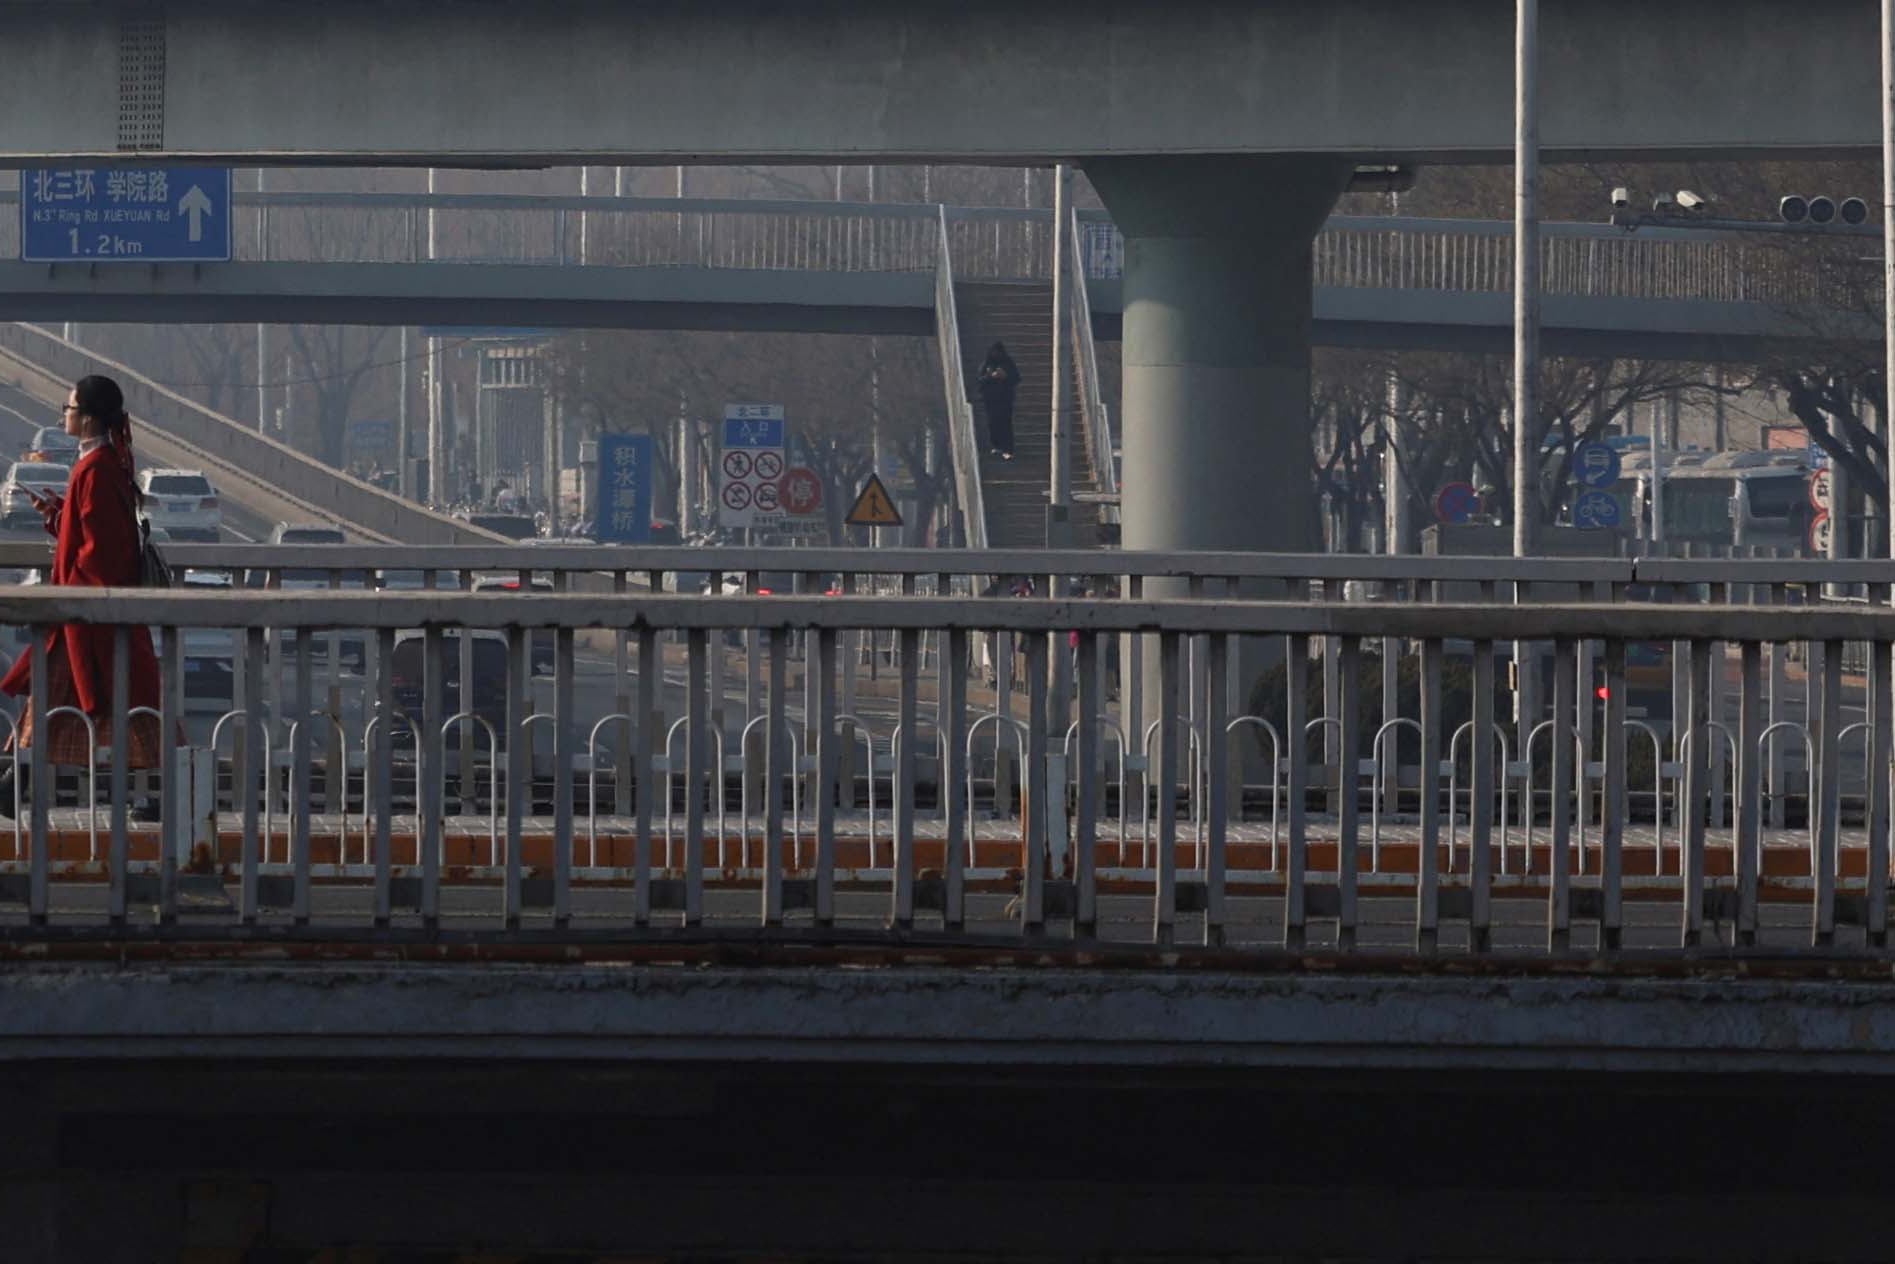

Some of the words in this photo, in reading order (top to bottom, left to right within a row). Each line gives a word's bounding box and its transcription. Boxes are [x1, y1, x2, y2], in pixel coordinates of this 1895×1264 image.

[33, 169, 95, 203] 北三环
[107, 169, 168, 203] 学院路
[59, 209, 81, 224] Ring
[85, 209, 98, 222] Rd
[104, 210, 151, 223] XUEYUAN
[156, 210, 170, 223] Rd
